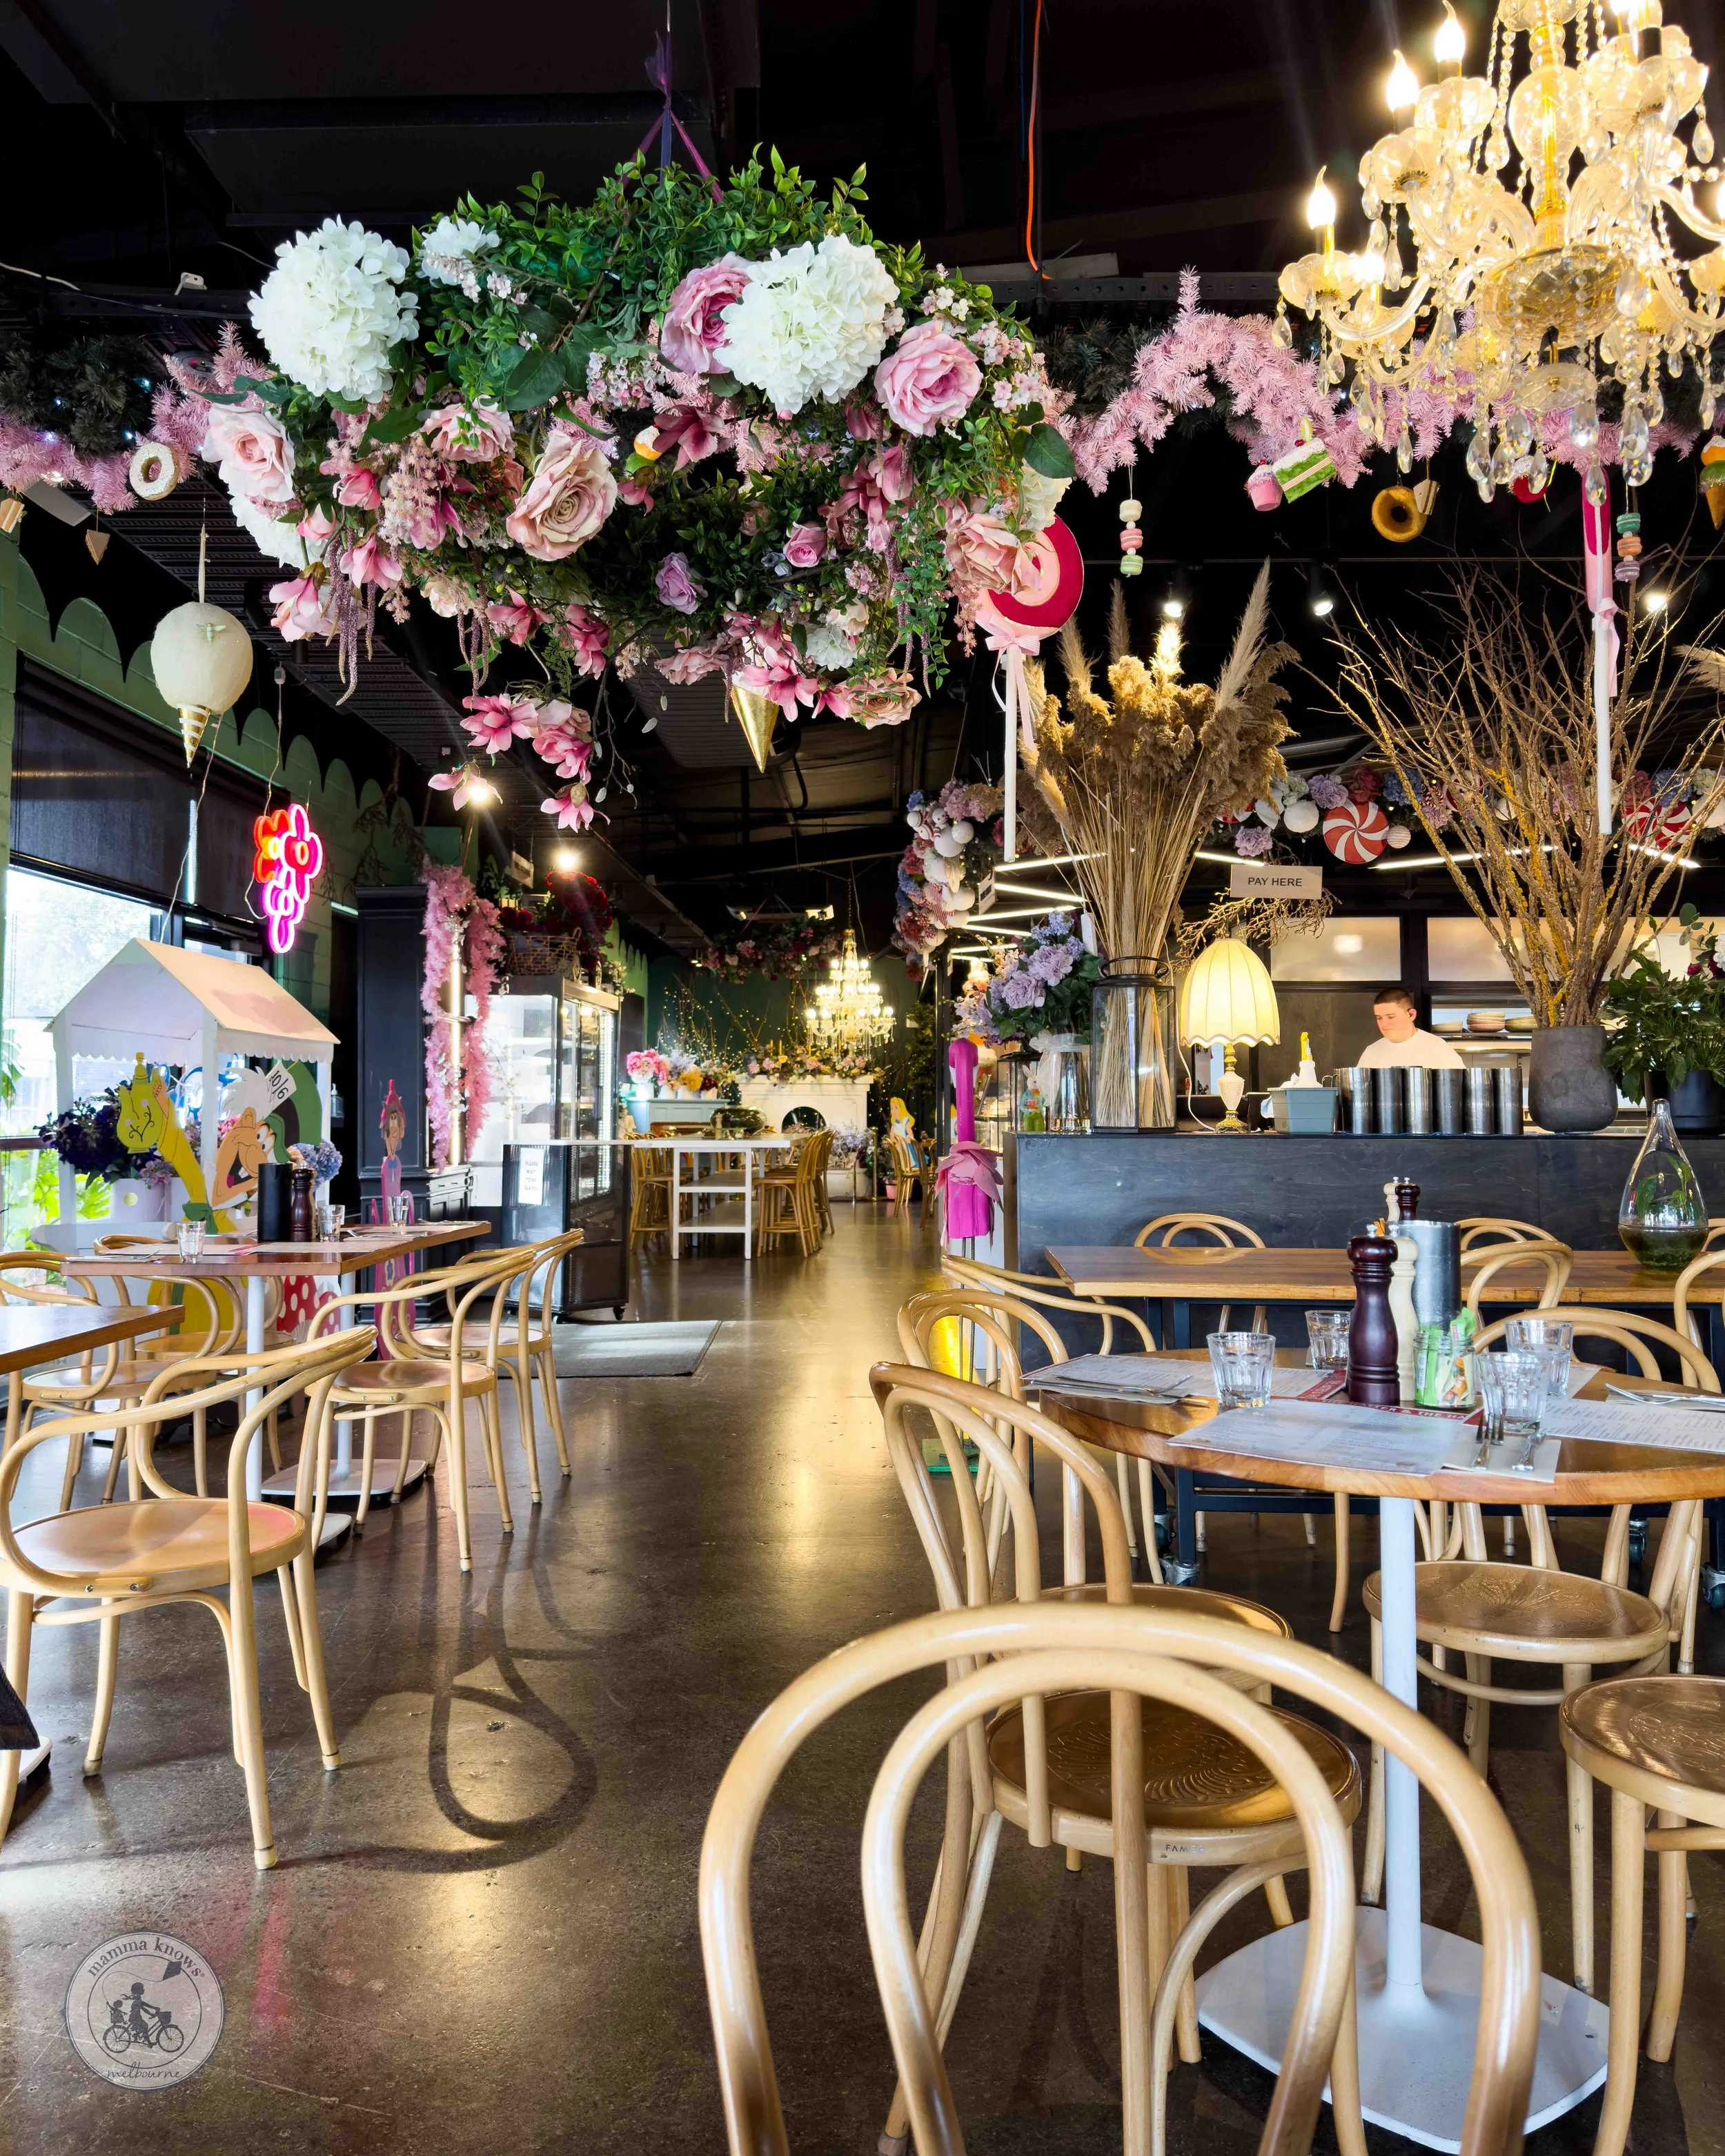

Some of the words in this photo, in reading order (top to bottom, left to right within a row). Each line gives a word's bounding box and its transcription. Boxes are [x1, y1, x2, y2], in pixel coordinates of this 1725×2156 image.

[1248, 877, 1269, 885] PAY
[1272, 878, 1303, 887] HERE
[269, 1070, 289, 1100] 10/6
[1165, 1844, 1205, 1854] FAMEG
